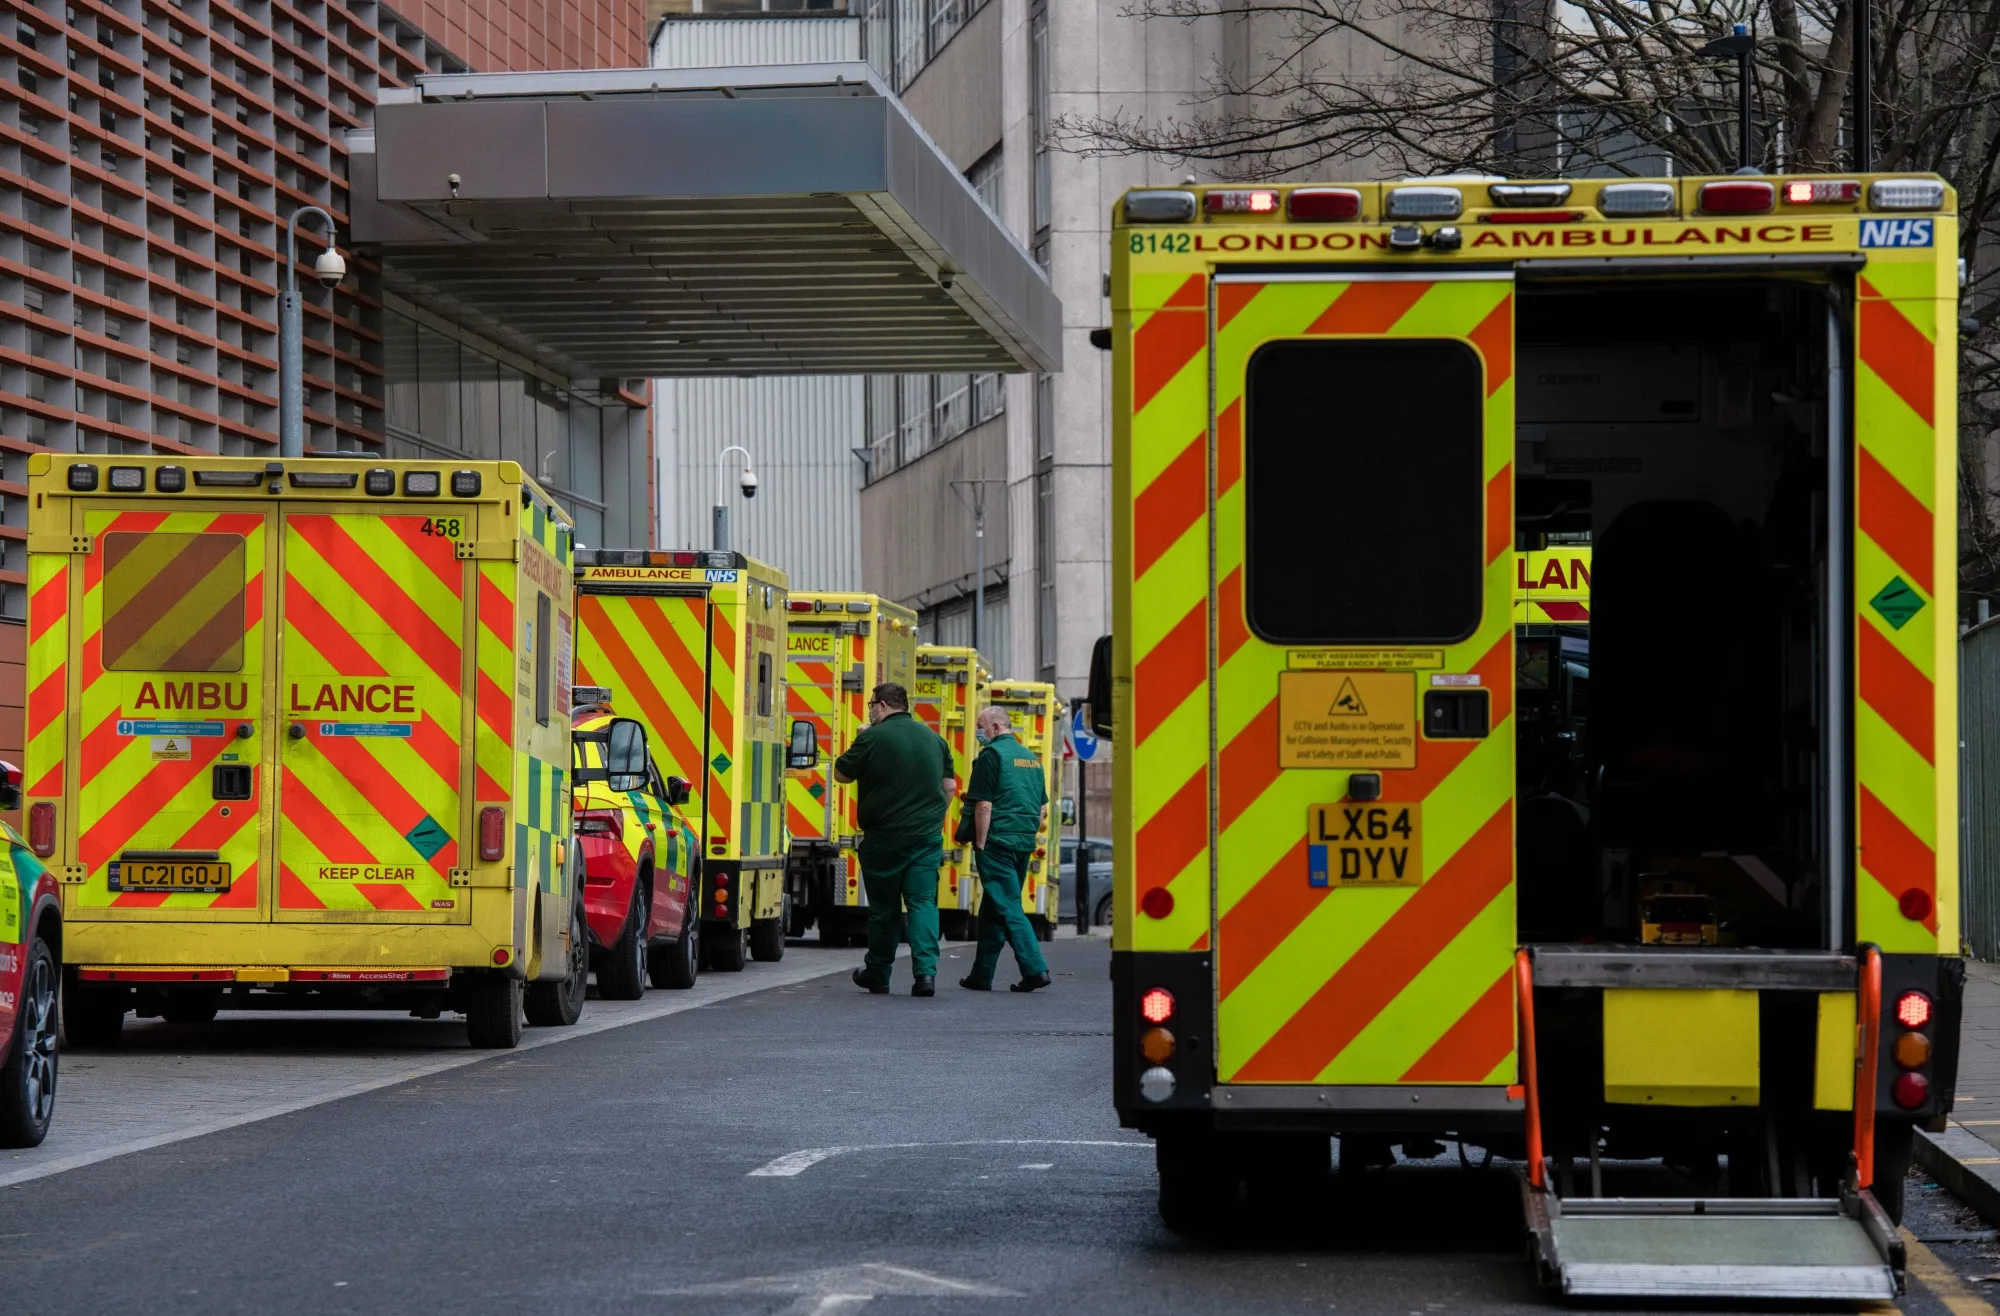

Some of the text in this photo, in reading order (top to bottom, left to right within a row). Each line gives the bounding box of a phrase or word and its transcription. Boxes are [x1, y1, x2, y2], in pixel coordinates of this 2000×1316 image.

[1130, 233, 1190, 254] 8142
[1194, 225, 1834, 252] LONDON AMBULANCE
[1860, 220, 1931, 247] NHS
[420, 518, 460, 538] 458
[591, 568, 691, 580] AMBULANCE
[706, 570, 737, 582] NHS
[134, 681, 415, 713] AMBU LANCE
[1318, 808, 1412, 841] LX64
[320, 868, 414, 880] KEEP CLEAR
[1340, 848, 1408, 879] DYV
[128, 866, 222, 885] LC21 GOJ
